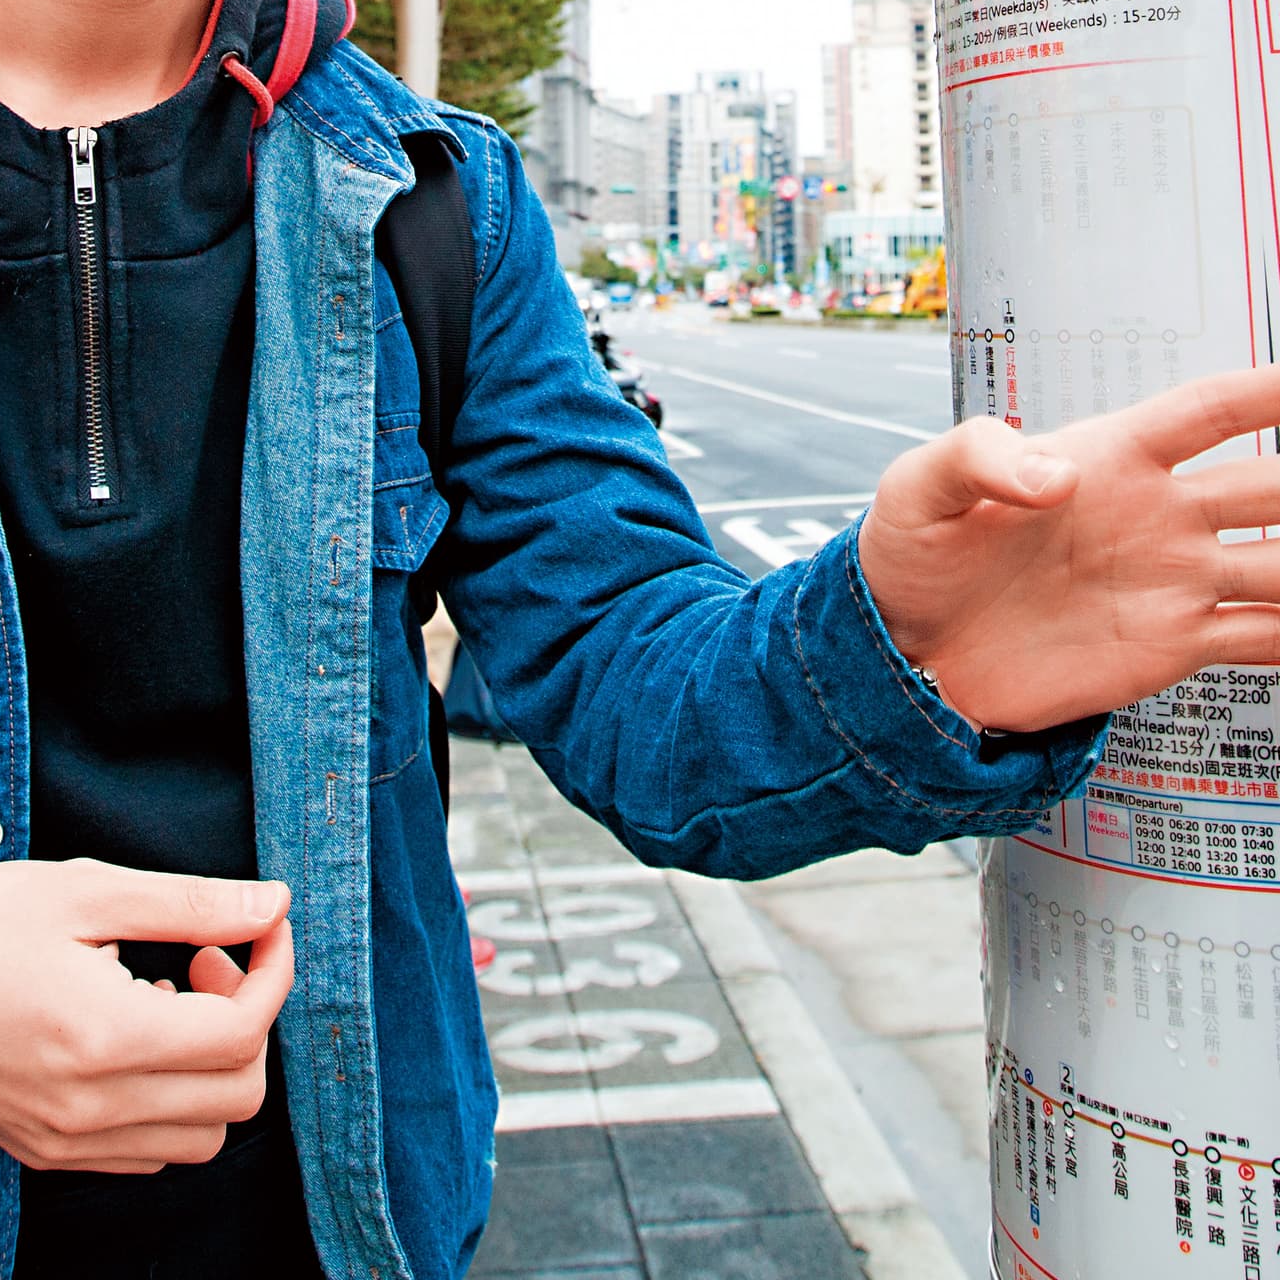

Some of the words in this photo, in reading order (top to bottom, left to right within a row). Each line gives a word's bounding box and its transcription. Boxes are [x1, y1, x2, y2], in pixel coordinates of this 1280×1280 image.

[1005, 346, 1018, 411] 行政園區
[1175, 688, 1271, 705] 05:40~22:00
[1226, 726, 1275, 744] (mins)
[1087, 809, 1119, 827] 例假日
[1135, 813, 1164, 828] 05:40
[1169, 818, 1200, 832] 06:20
[1204, 822, 1237, 835] 07:00
[1241, 824, 1274, 838] 07:30
[1087, 823, 1130, 841] Weekends
[1135, 827, 1165, 841] 09:00
[1169, 832, 1200, 846] 09:30
[1206, 836, 1237, 849] 10:00
[1242, 839, 1274, 851] 10:40
[1136, 841, 1166, 855] 12:00
[1170, 846, 1201, 859] 12:40
[1206, 850, 1238, 863] 13:20
[1243, 853, 1275, 866] 14:00
[1137, 854, 1166, 868] 15:20
[1171, 860, 1202, 873] 16:00
[1207, 864, 1239, 877] 16:30
[1244, 867, 1276, 880] 16:30
[1061, 1065, 1071, 1083] 2
[1112, 1140, 1129, 1200] 高公局
[1172, 1158, 1193, 1239] 長庚醫院
[1205, 1166, 1226, 1247] 復興一路
